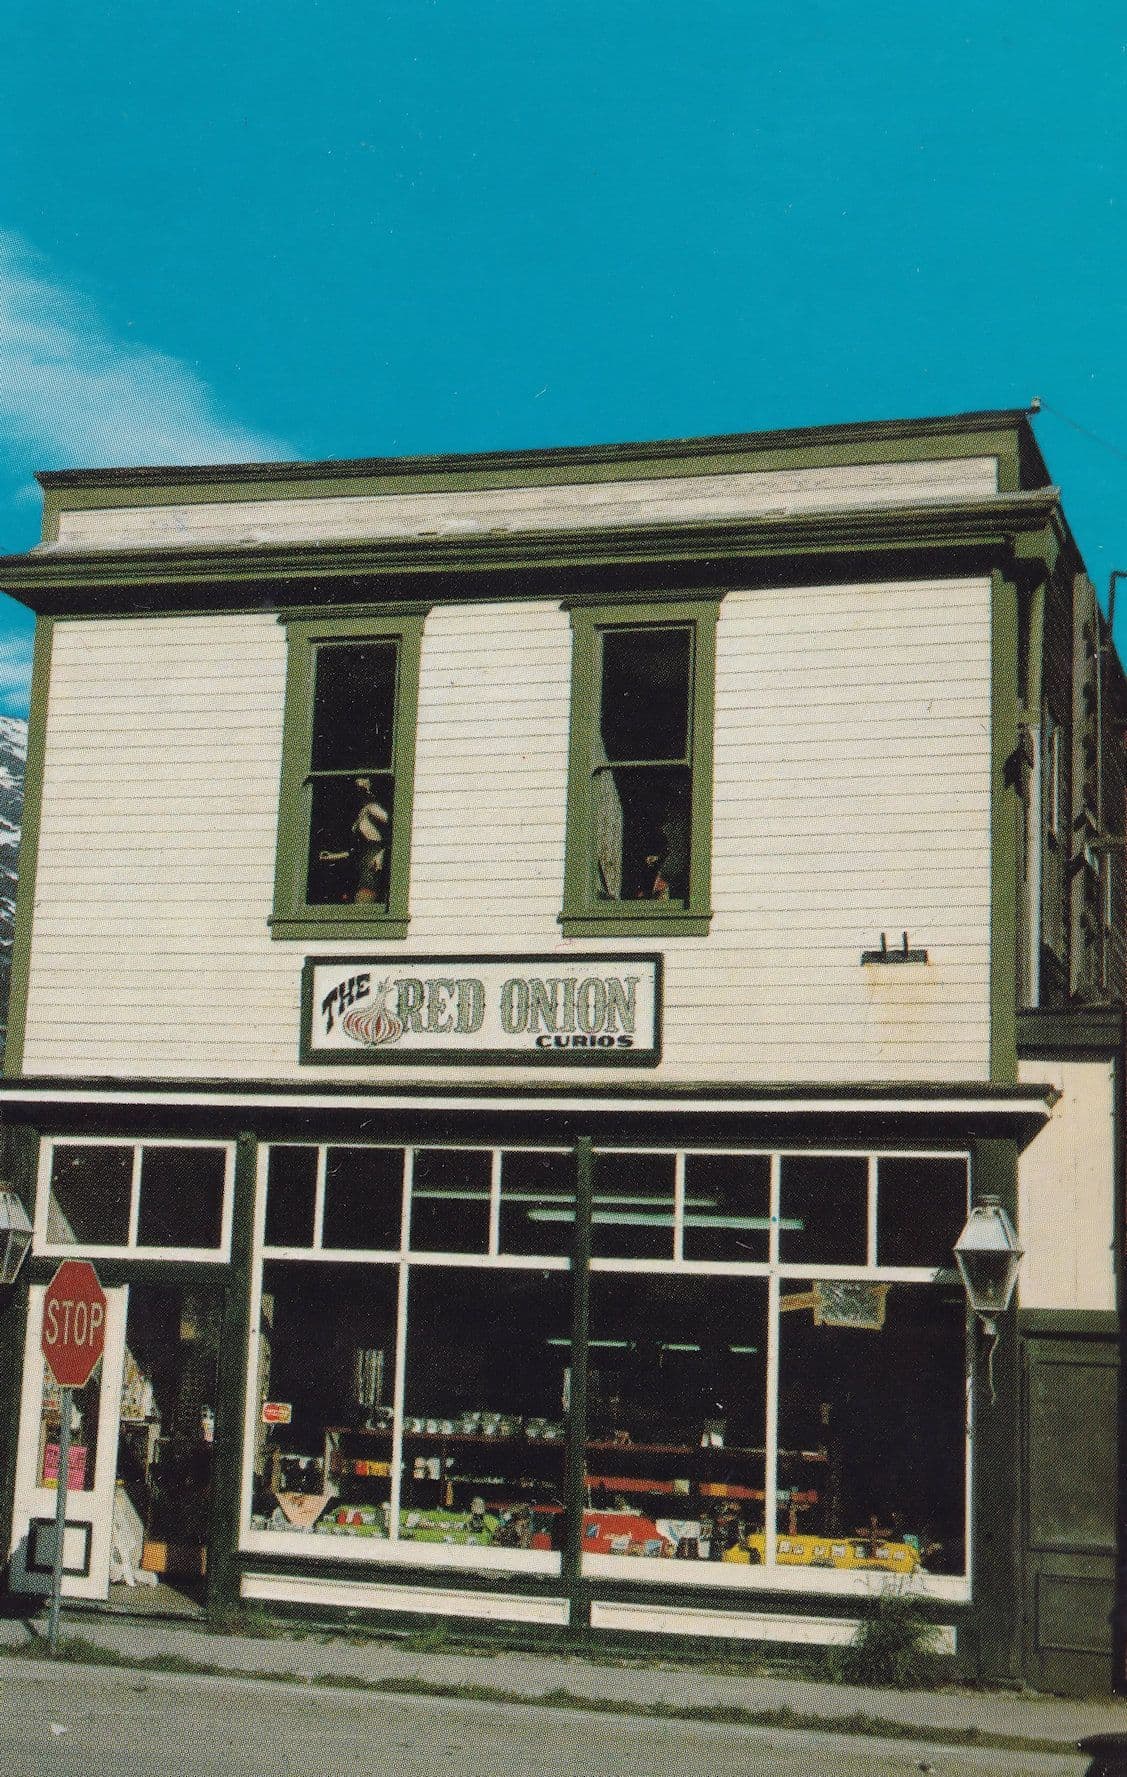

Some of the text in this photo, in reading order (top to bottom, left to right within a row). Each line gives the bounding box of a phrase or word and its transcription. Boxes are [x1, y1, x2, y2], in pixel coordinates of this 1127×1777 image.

[322, 973, 640, 1034] THE RED ONION
[536, 1034, 634, 1049] CURIOS
[46, 1299, 103, 1346] STOP
